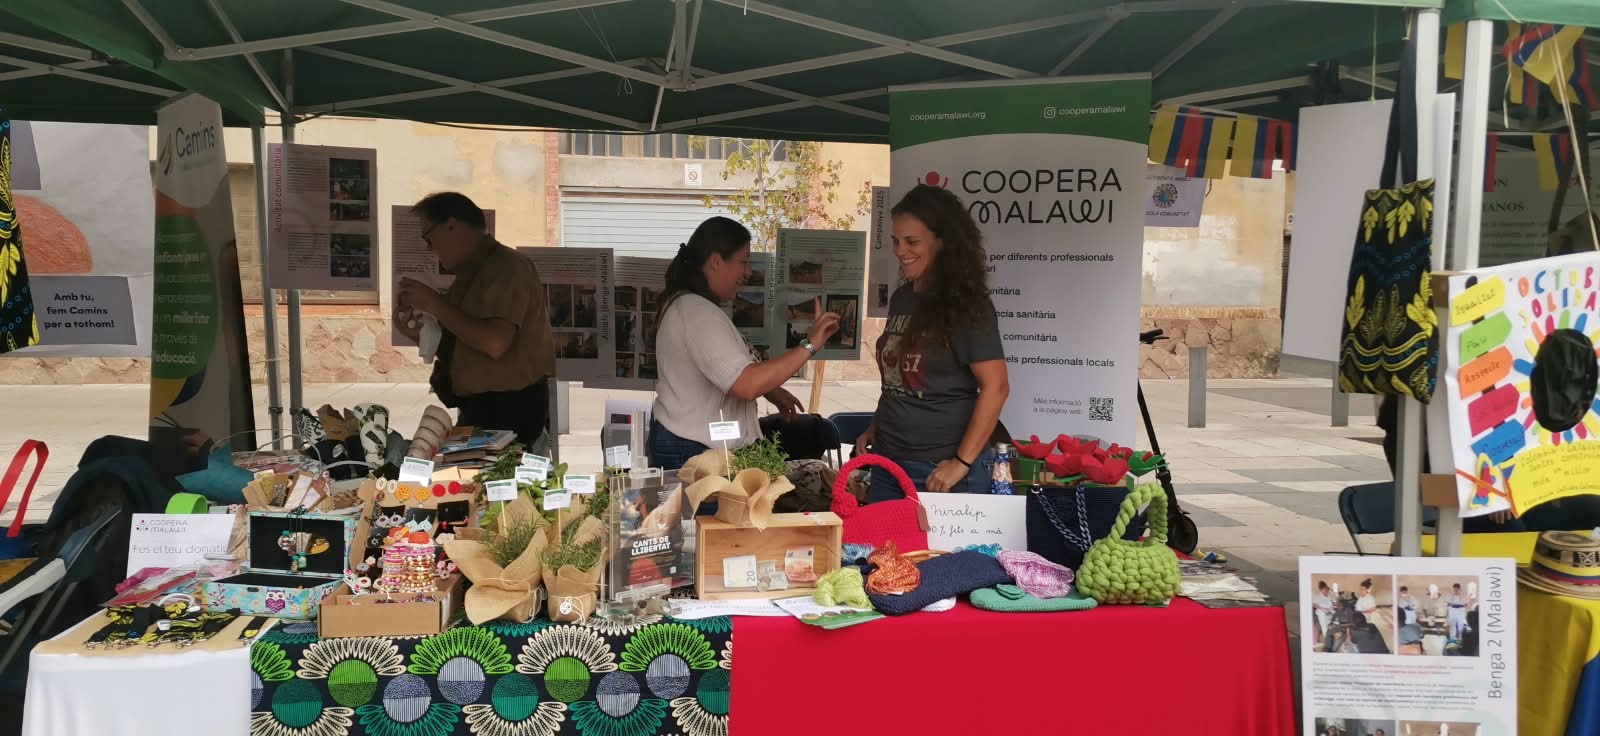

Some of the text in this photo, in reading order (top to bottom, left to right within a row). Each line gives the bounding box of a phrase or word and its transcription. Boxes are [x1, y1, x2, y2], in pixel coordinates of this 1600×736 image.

[910, 110, 986, 121] cooperamalawi.org
[1059, 105, 1126, 117] cooperamalawi
[175, 120, 215, 158] Camins
[962, 167, 1122, 194] COOPERA
[967, 199, 1113, 225] MALAWI
[989, 253, 1114, 263] per diferents professionals
[1518, 266, 1600, 298] OCTUB
[54, 292, 95, 303] Amb tu,
[46, 306, 109, 315] fem Camins
[1016, 309, 1056, 319] sanitària
[1518, 287, 1600, 329] SOLIDA
[44, 319, 116, 331] per a tothom!
[1003, 332, 1057, 342] comunitària
[1021, 355, 1084, 366] professionals
[1086, 357, 1115, 367] locals
[949, 525, 965, 537] fets
[632, 535, 670, 549] CANTS DE
[133, 544, 151, 554] Fes
[153, 543, 162, 554] el
[164, 544, 182, 554] teu
[631, 541, 671, 556] LLIBERTAT
[1485, 565, 1506, 699] Benga 2 (Malawi)
